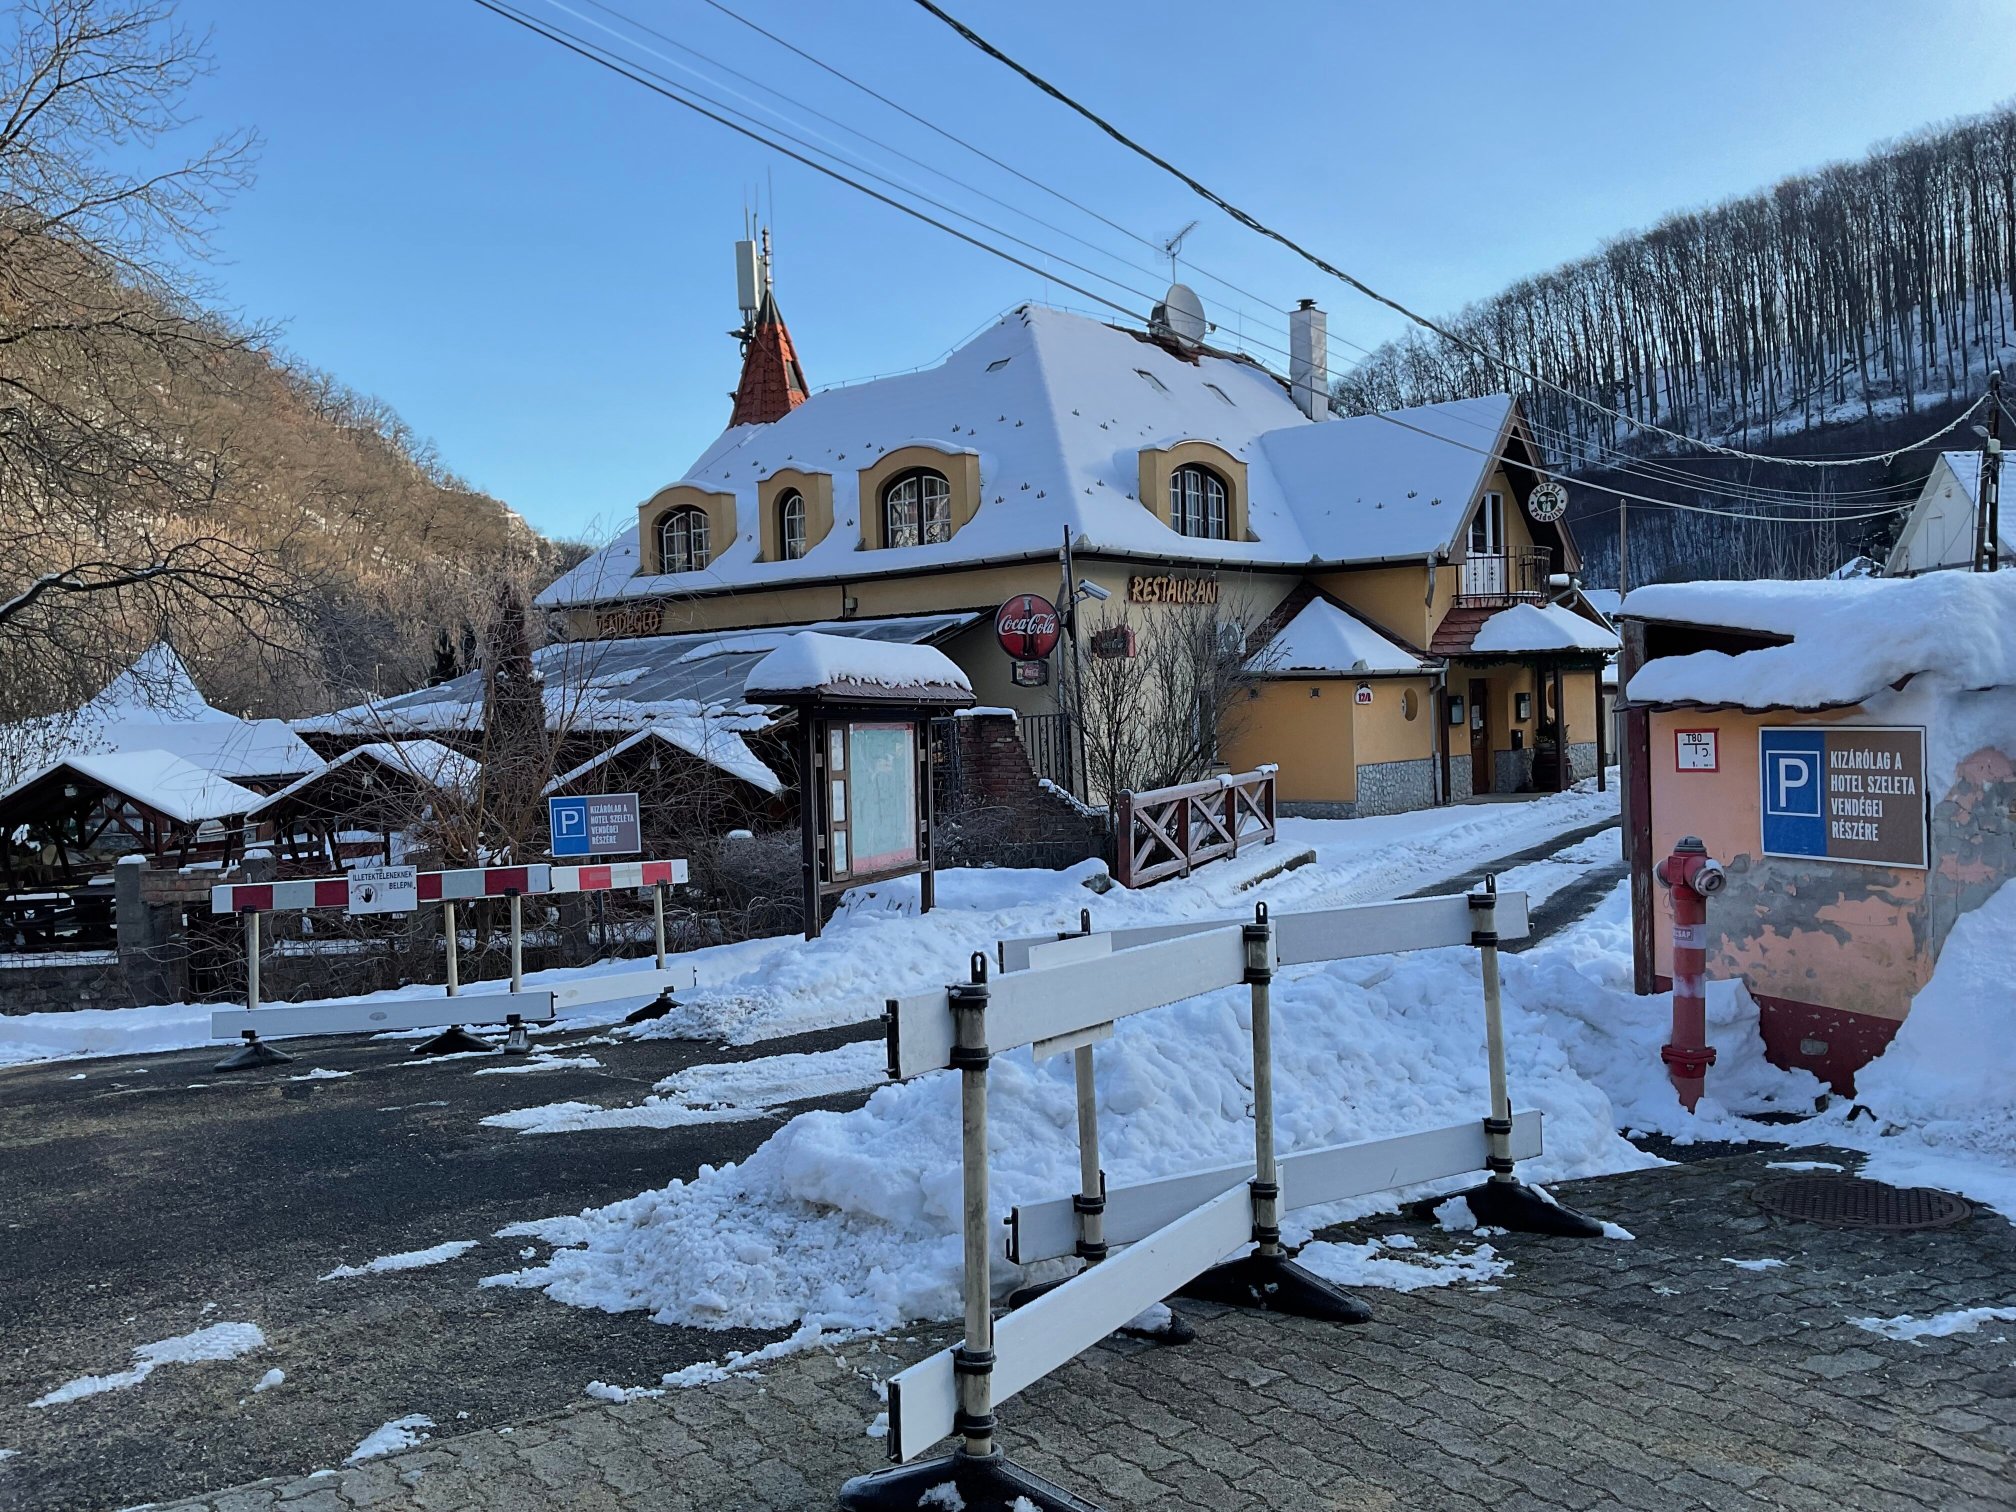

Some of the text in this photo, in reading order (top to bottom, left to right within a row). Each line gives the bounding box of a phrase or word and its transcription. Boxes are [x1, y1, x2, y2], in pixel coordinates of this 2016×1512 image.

[1532, 484, 1562, 498] MOTEL
[998, 614, 1057, 635] Coca-Cola
[1685, 733, 1703, 743] T80
[1830, 749, 1902, 770] KIZÁRÓLAG A
[1778, 757, 1809, 808] P
[1830, 775, 1916, 795] HOTEL SZELETA
[590, 804, 628, 814] KIZÁRÓLAG A
[1831, 796, 1883, 818] VENDÉGEI
[561, 810, 579, 834] P
[590, 814, 634, 824] HOTEL SZELETA
[591, 824, 619, 834] VENDÉGEI
[592, 835, 617, 845] RÉSZÉRE
[1831, 819, 1879, 842] RÉSZÉRE
